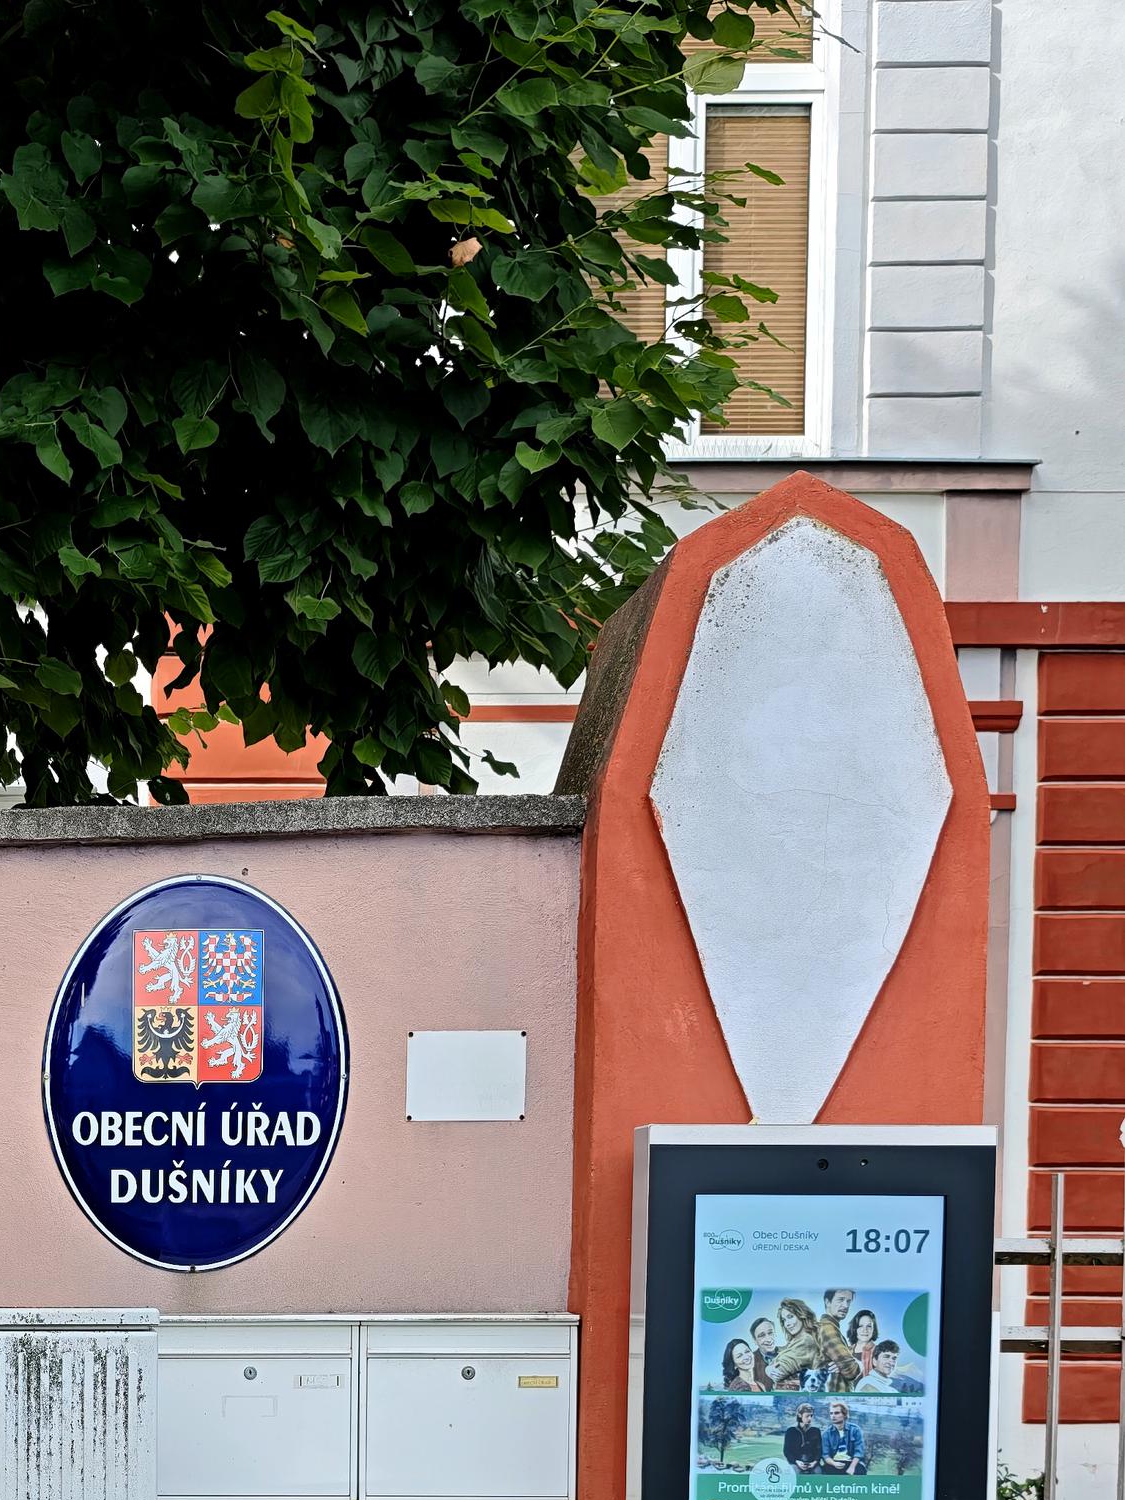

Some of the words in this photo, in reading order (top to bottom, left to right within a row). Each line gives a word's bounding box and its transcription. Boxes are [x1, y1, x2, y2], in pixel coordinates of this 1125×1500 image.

[72, 1102, 208, 1147] OBECNÍ
[221, 1102, 321, 1147] ÚŘAD
[110, 1160, 285, 1204] DUŠNÍKY
[752, 1230, 778, 1240] Obec
[781, 1229, 819, 1241] Dušníky
[845, 1228, 930, 1254] 18:07
[752, 1242, 781, 1251] ÚŘEDNÍ
[704, 1295, 739, 1305] Dušníky
[815, 1484, 822, 1493] v
[826, 1482, 868, 1494] Letním
[871, 1482, 900, 1494] kině!
